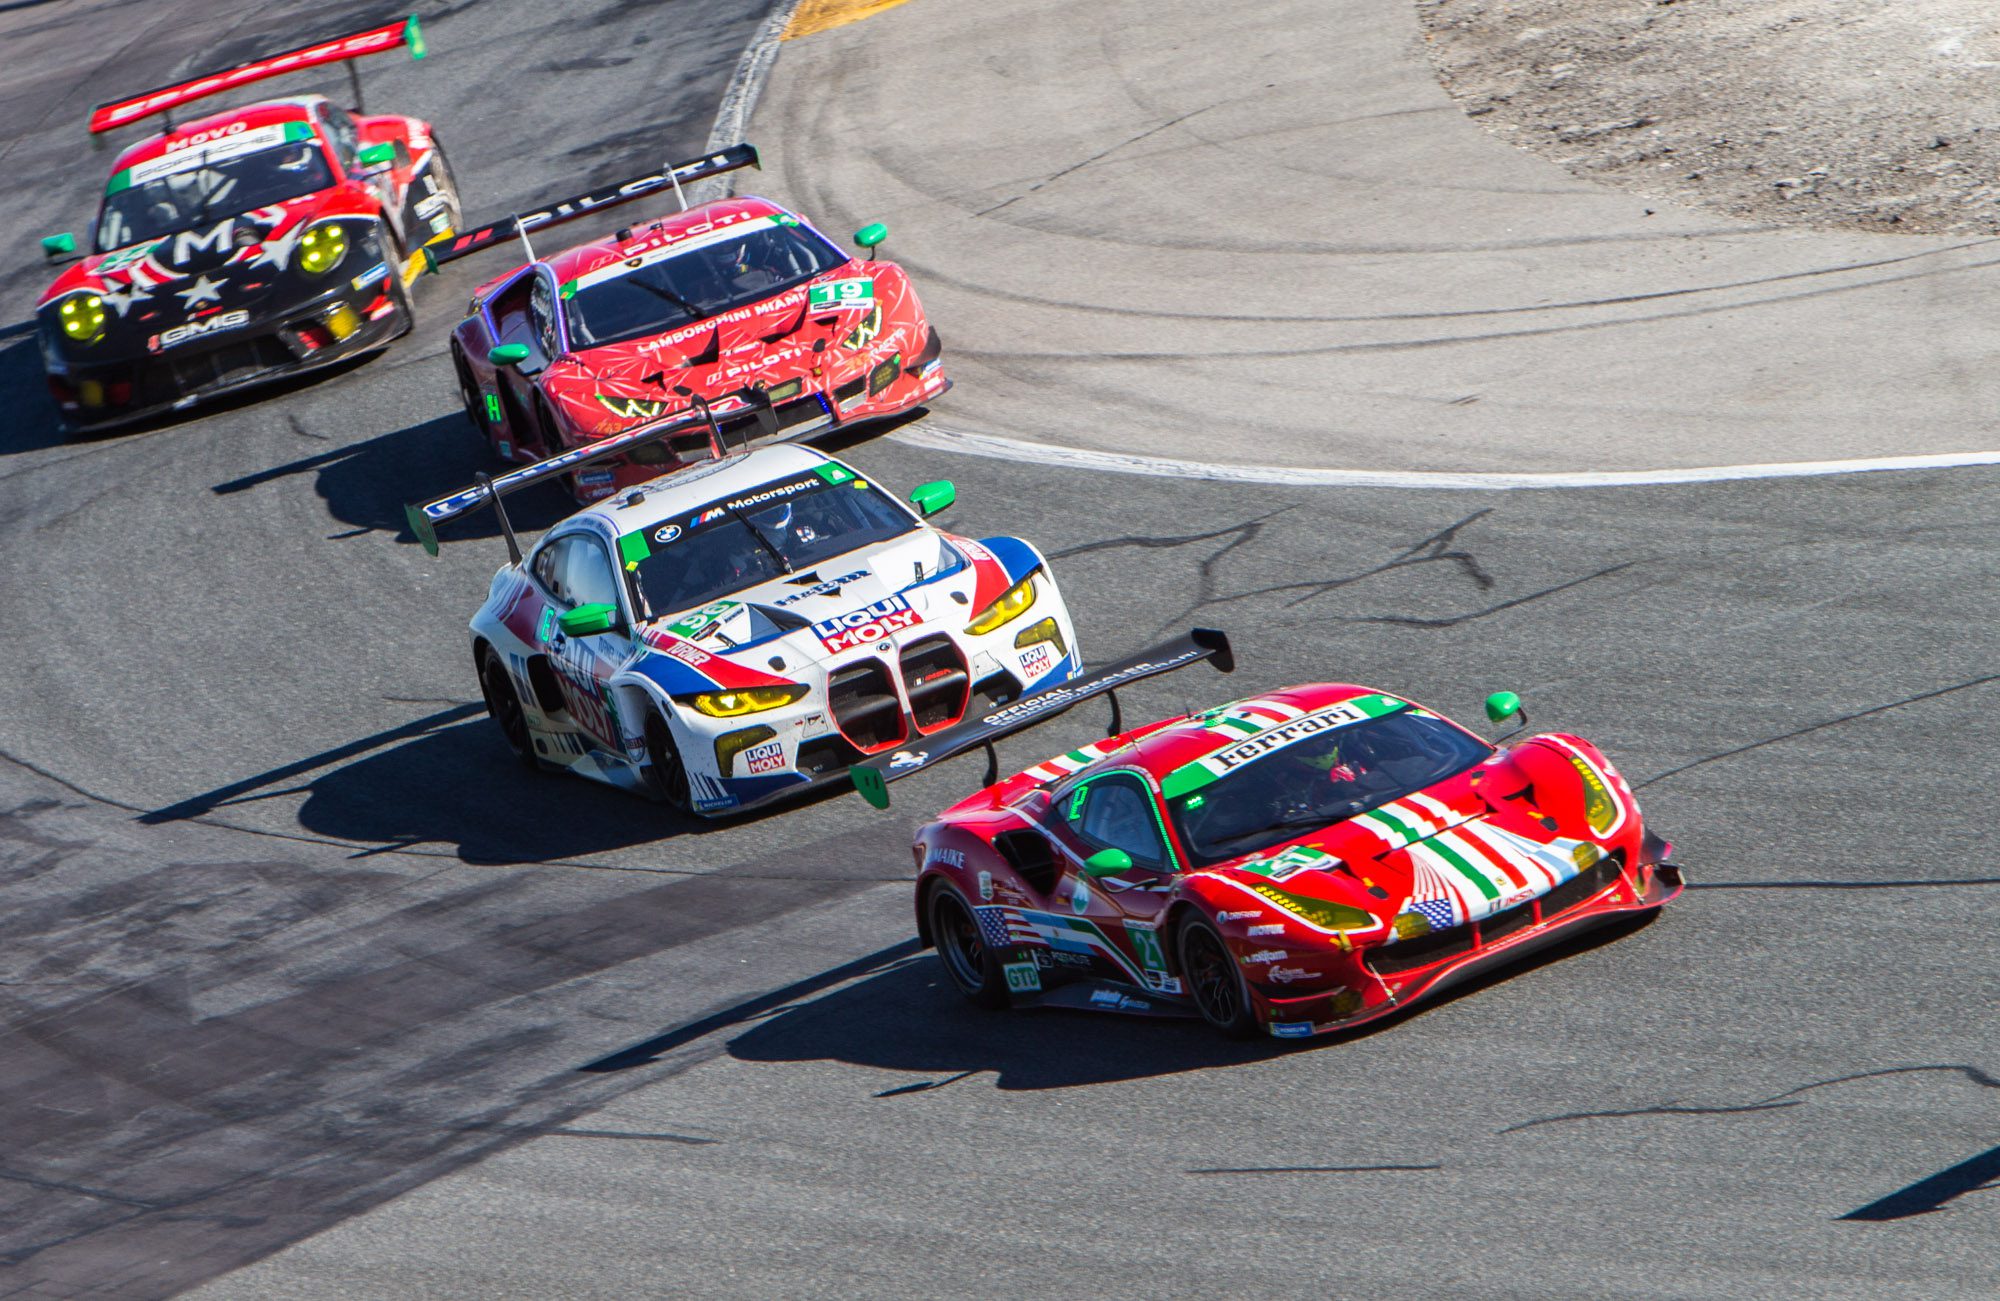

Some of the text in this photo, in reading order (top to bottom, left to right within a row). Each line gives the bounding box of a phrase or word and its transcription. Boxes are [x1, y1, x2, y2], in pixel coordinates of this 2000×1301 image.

[165, 122, 247, 154] MOVO
[514, 153, 730, 230] PILOTI
[623, 211, 752, 257] PILOTI
[818, 282, 864, 301] 19
[159, 309, 250, 348] GMG
[636, 309, 752, 353] LAMBORGHINI
[754, 292, 809, 316] MIAMI
[726, 348, 803, 378] PILOTI
[727, 477, 820, 511] Motorsport
[679, 603, 730, 630] 96
[818, 598, 912, 637] LIQUI
[827, 608, 916, 653] MOLY
[1020, 646, 1047, 665] LIQUI
[1024, 658, 1051, 677] MOLY
[982, 687, 1074, 726] OFFICIAL
[745, 743, 781, 762] LIQUI
[1208, 706, 1360, 771] Ferrari
[750, 756, 785, 774] MOLY
[1135, 931, 1166, 967] 21
[1007, 965, 1039, 987] GTD
